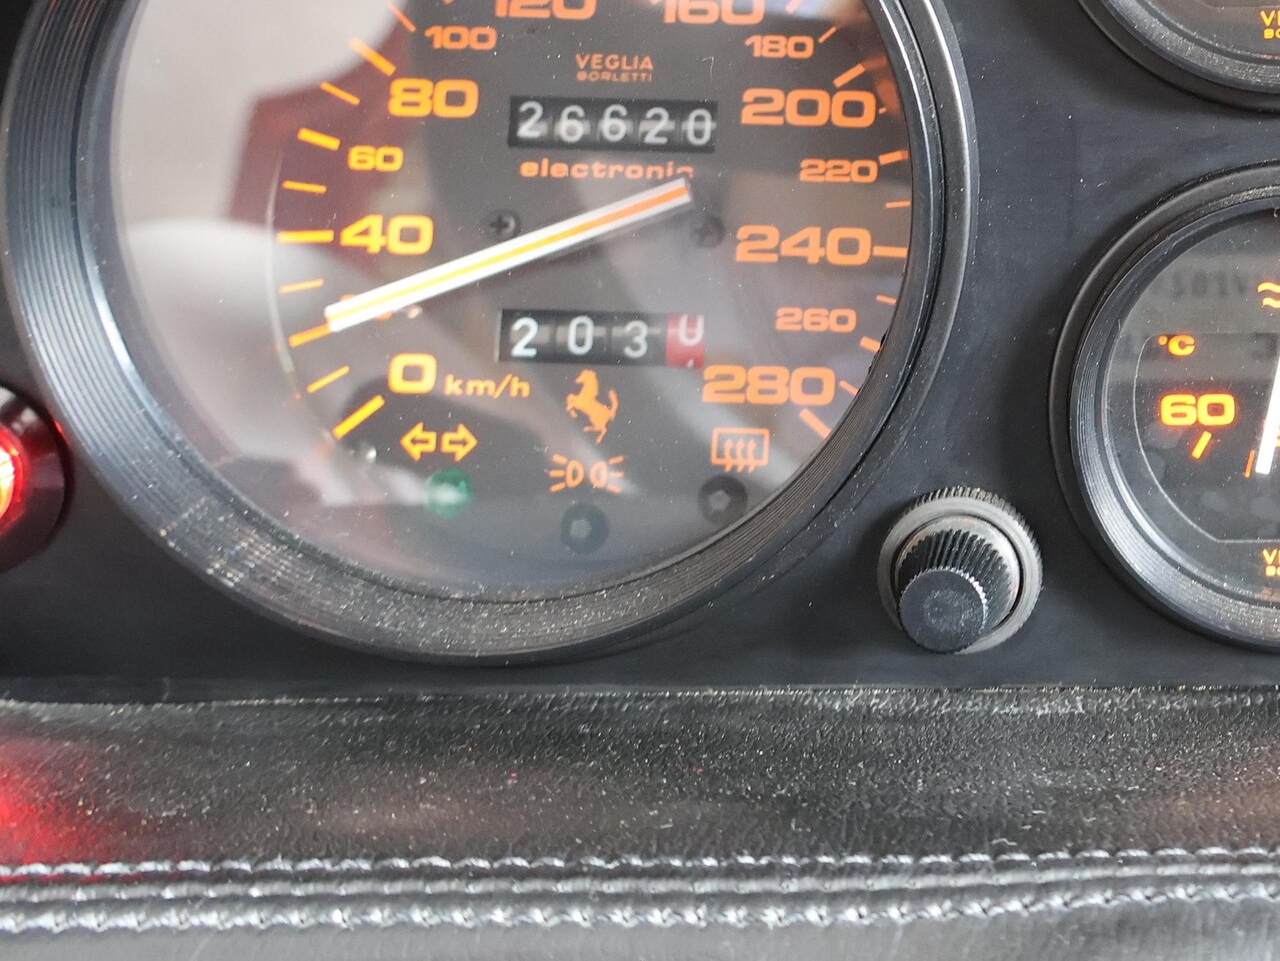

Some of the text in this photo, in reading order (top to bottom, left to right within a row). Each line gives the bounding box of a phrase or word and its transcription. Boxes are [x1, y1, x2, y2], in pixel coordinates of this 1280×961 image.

[424, 27, 496, 50] 100
[745, 35, 813, 59] 180
[575, 54, 654, 70] VEGLIA
[576, 71, 652, 82] BORLETTI
[388, 79, 478, 118] 80
[740, 89, 876, 128] 200
[517, 100, 713, 146] 26620
[348, 147, 403, 171] 60
[800, 159, 877, 183] 220
[340, 215, 434, 257] 40
[736, 225, 872, 266] 240
[775, 308, 856, 333] 260
[388, 353, 530, 398] 0 km/h
[704, 366, 835, 406] 280
[1159, 393, 1236, 428] 60
